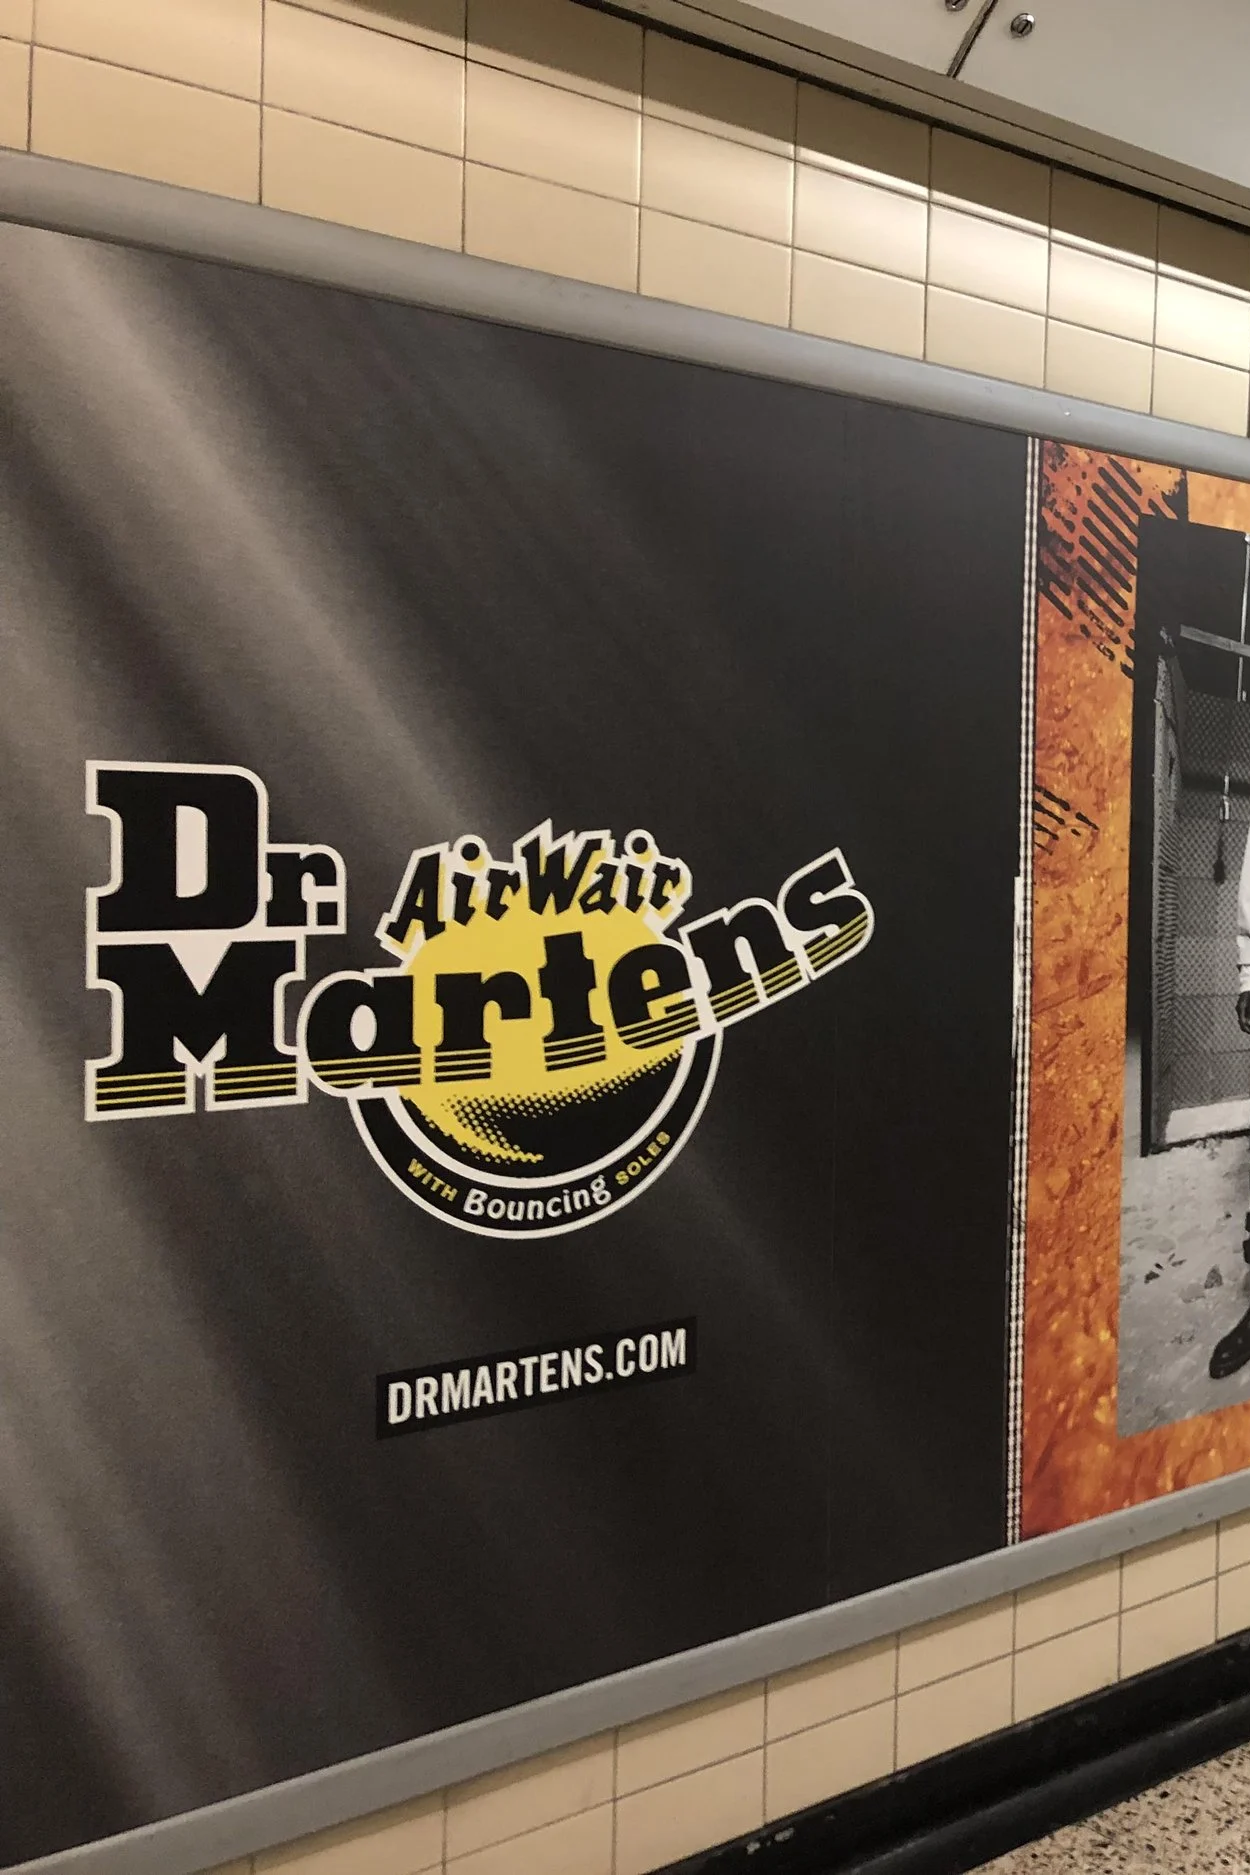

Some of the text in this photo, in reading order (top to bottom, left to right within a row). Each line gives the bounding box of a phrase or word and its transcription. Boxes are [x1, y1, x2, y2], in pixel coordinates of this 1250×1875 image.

[86, 760, 346, 934] Dr.
[376, 818, 693, 960] AirWair
[86, 848, 875, 1121] Martens
[407, 1131, 671, 1221] WITH Bouncing SOLES
[388, 1327, 687, 1424] DRMARTENS.COM
